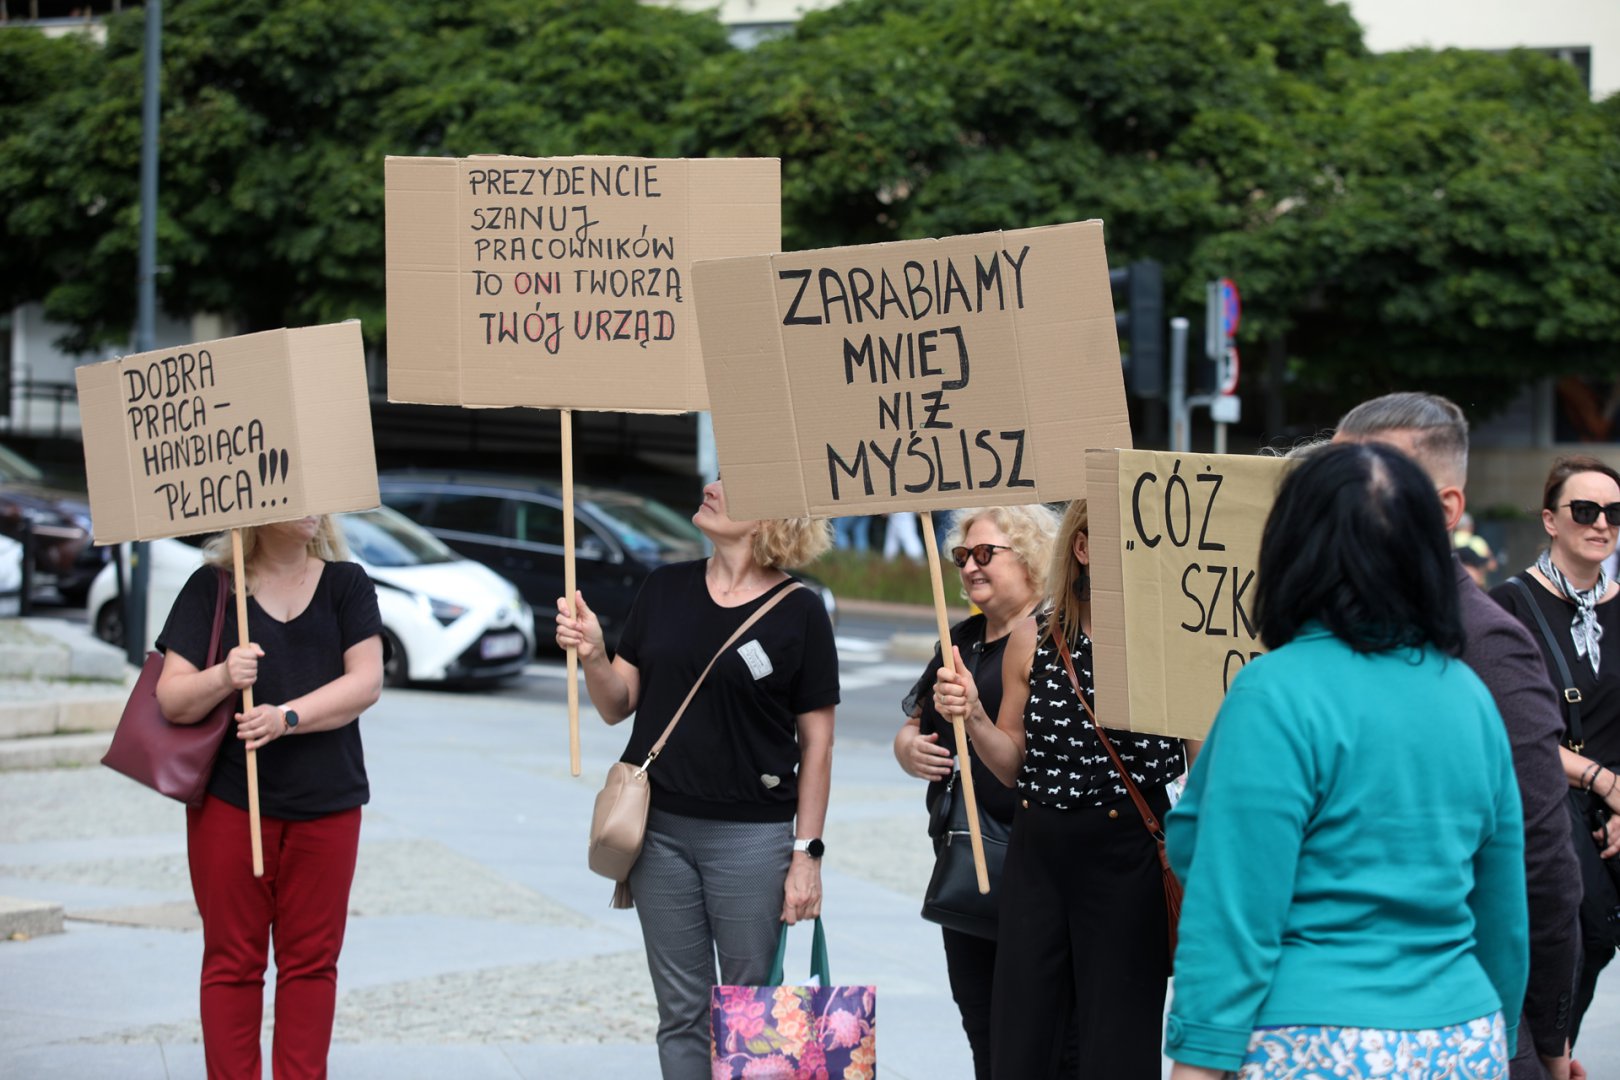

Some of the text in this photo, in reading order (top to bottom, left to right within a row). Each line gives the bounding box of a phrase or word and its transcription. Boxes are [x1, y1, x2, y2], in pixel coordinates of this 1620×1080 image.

[469, 164, 662, 198] PREZYDENCIE
[471, 205, 600, 242] SZANUJ
[474, 224, 674, 262] PRACOWNIKÓW
[472, 267, 684, 303] TO ONI TWORZĄ
[778, 245, 1030, 325] ZARABIAMY
[479, 302, 675, 355] TWÓJ URZĄD
[123, 350, 215, 403] DOBRA
[843, 325, 970, 390] MNIEJ
[127, 396, 207, 441] PRACA
[142, 419, 264, 477] HAŃBIĄCA
[826, 429, 1035, 501] MYŚLISZ
[1126, 459, 1226, 551] „CÓŻ
[1180, 562, 1257, 641] SZK
